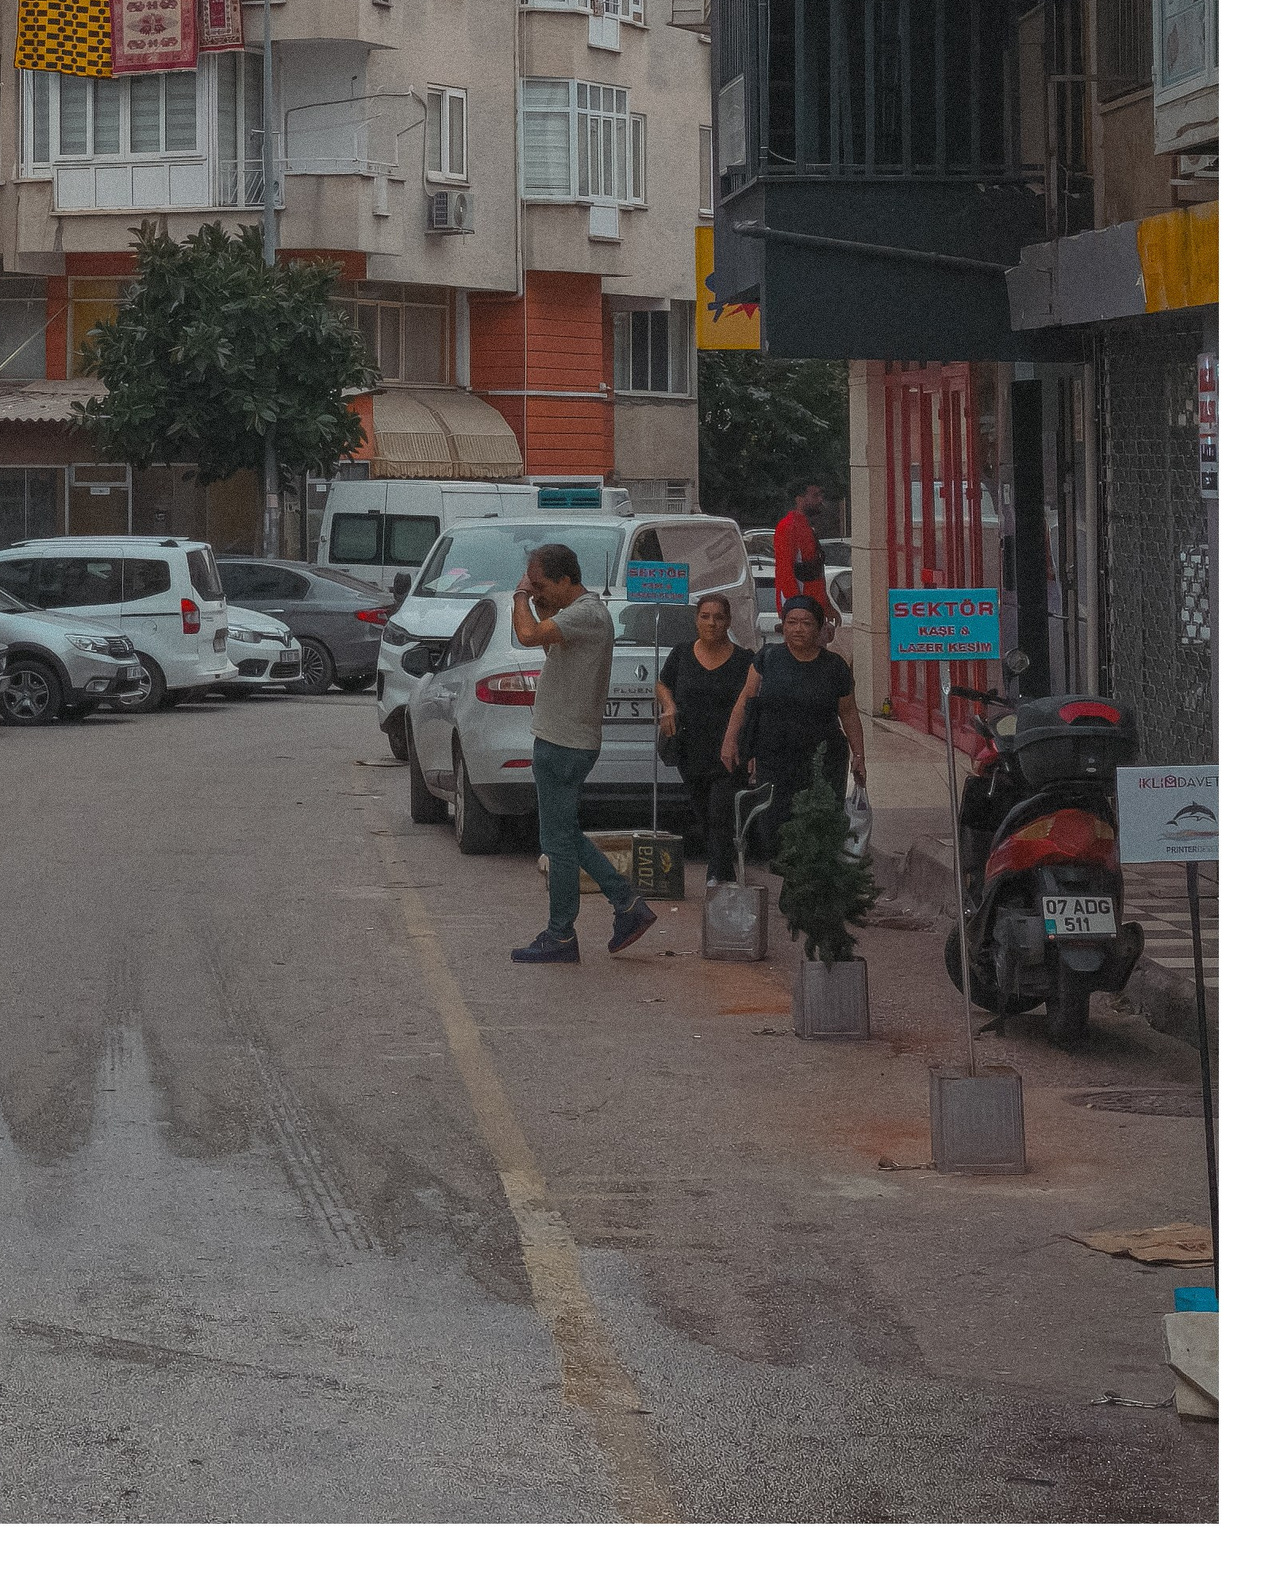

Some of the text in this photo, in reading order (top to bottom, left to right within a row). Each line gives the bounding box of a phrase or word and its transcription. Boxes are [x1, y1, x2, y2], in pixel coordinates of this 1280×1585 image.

[894, 599, 993, 618] SEKTÖR
[919, 626, 970, 637] KAŞE &
[899, 642, 992, 653] LAZER KESİM
[605, 702, 620, 717] 07
[631, 702, 639, 717] S
[1046, 899, 1111, 915] 07 ADG
[1065, 917, 1091, 932] 511
